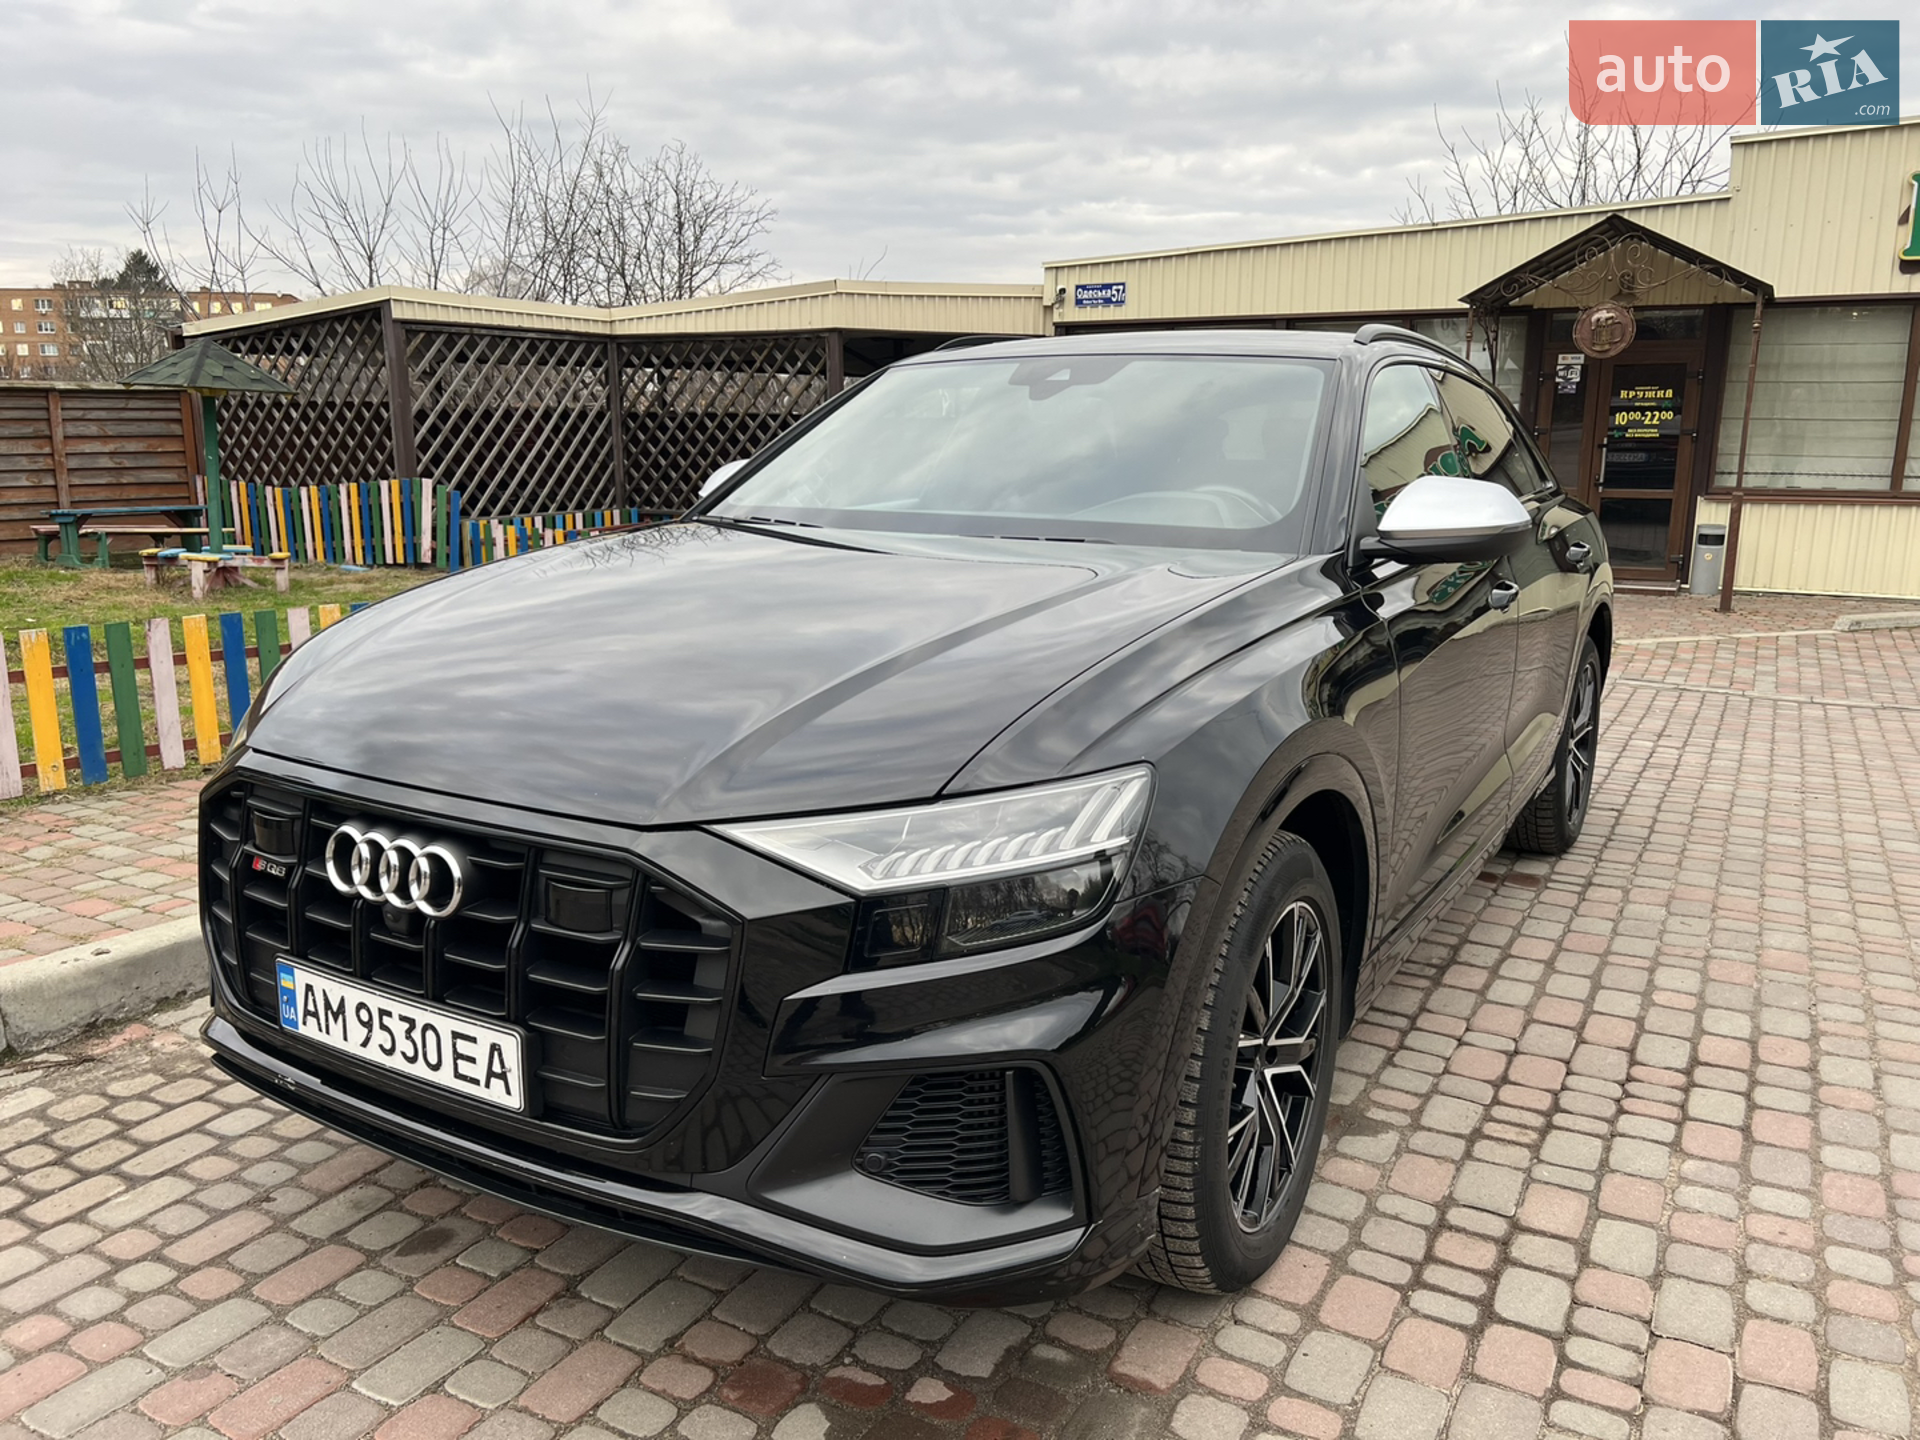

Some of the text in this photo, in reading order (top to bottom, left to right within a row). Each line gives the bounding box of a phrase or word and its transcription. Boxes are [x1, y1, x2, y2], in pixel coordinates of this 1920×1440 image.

[1076, 288, 1111, 298] Одеська
[1620, 389, 1673, 399] КРУЖКА
[282, 1003, 297, 1022] UA
